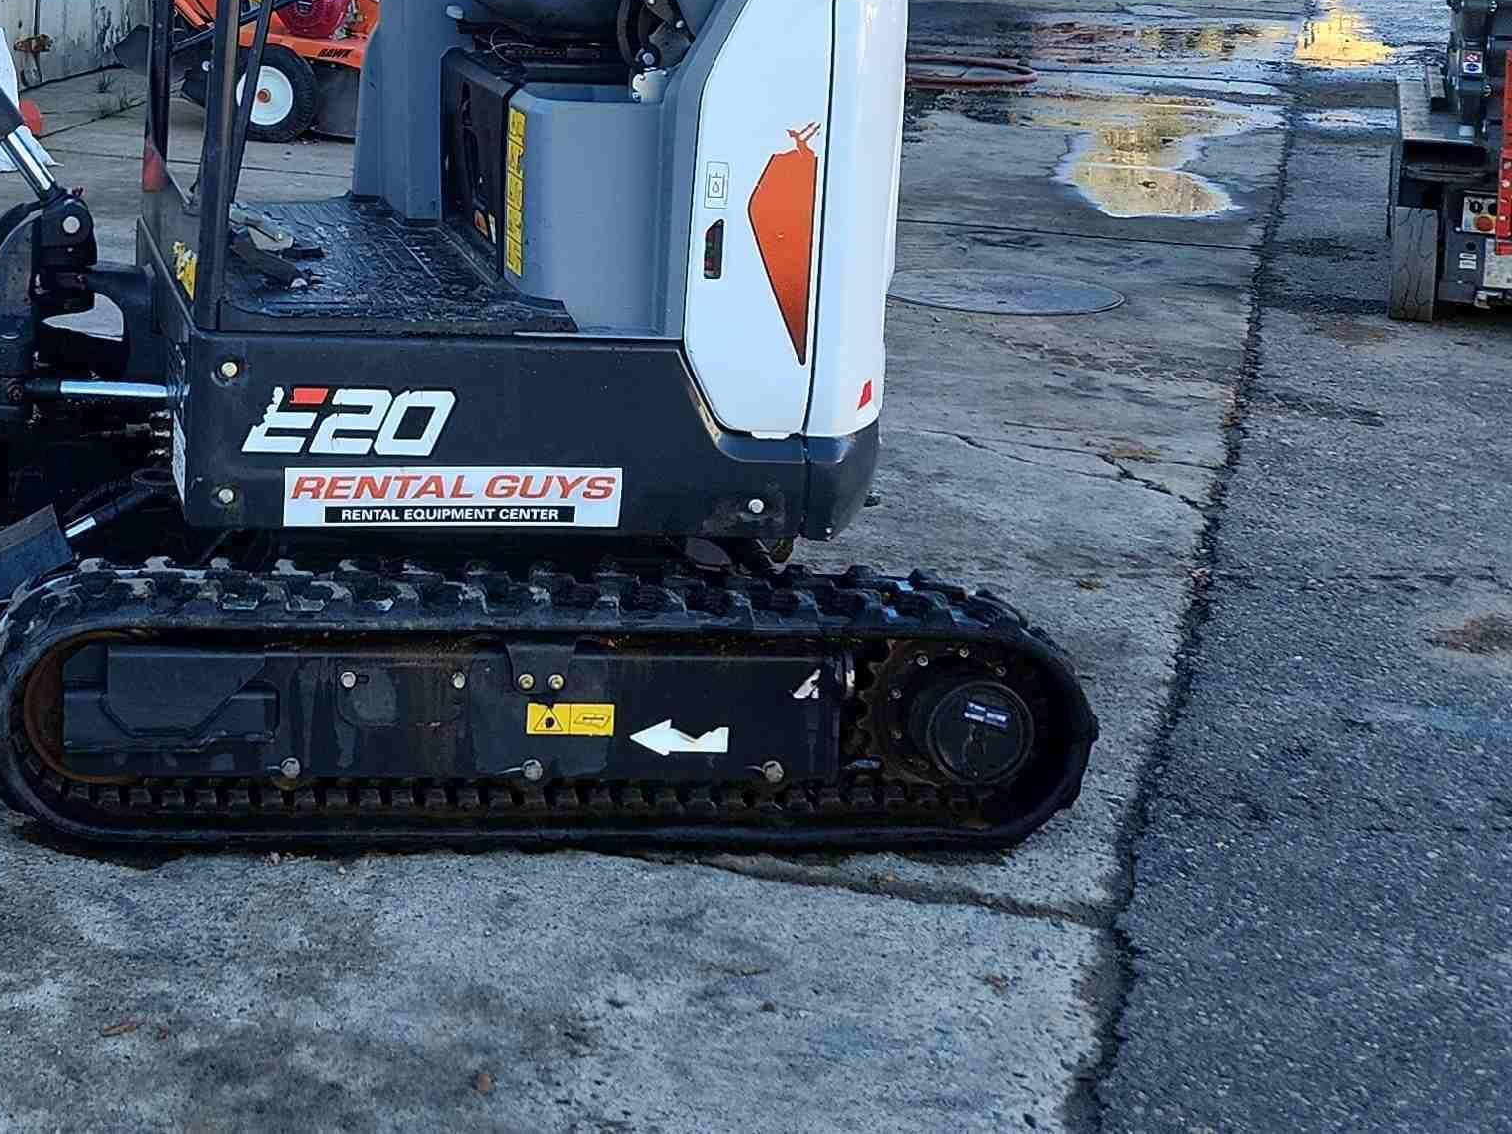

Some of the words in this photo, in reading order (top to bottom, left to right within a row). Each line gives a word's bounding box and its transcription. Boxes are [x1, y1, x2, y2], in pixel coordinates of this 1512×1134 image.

[242, 387, 456, 456] E20
[291, 475, 474, 500] RENTAL
[483, 475, 618, 500] GUYS
[341, 507, 400, 522] RENTAL
[403, 507, 496, 521] EQUIPMENT
[498, 507, 559, 521] CENTER
